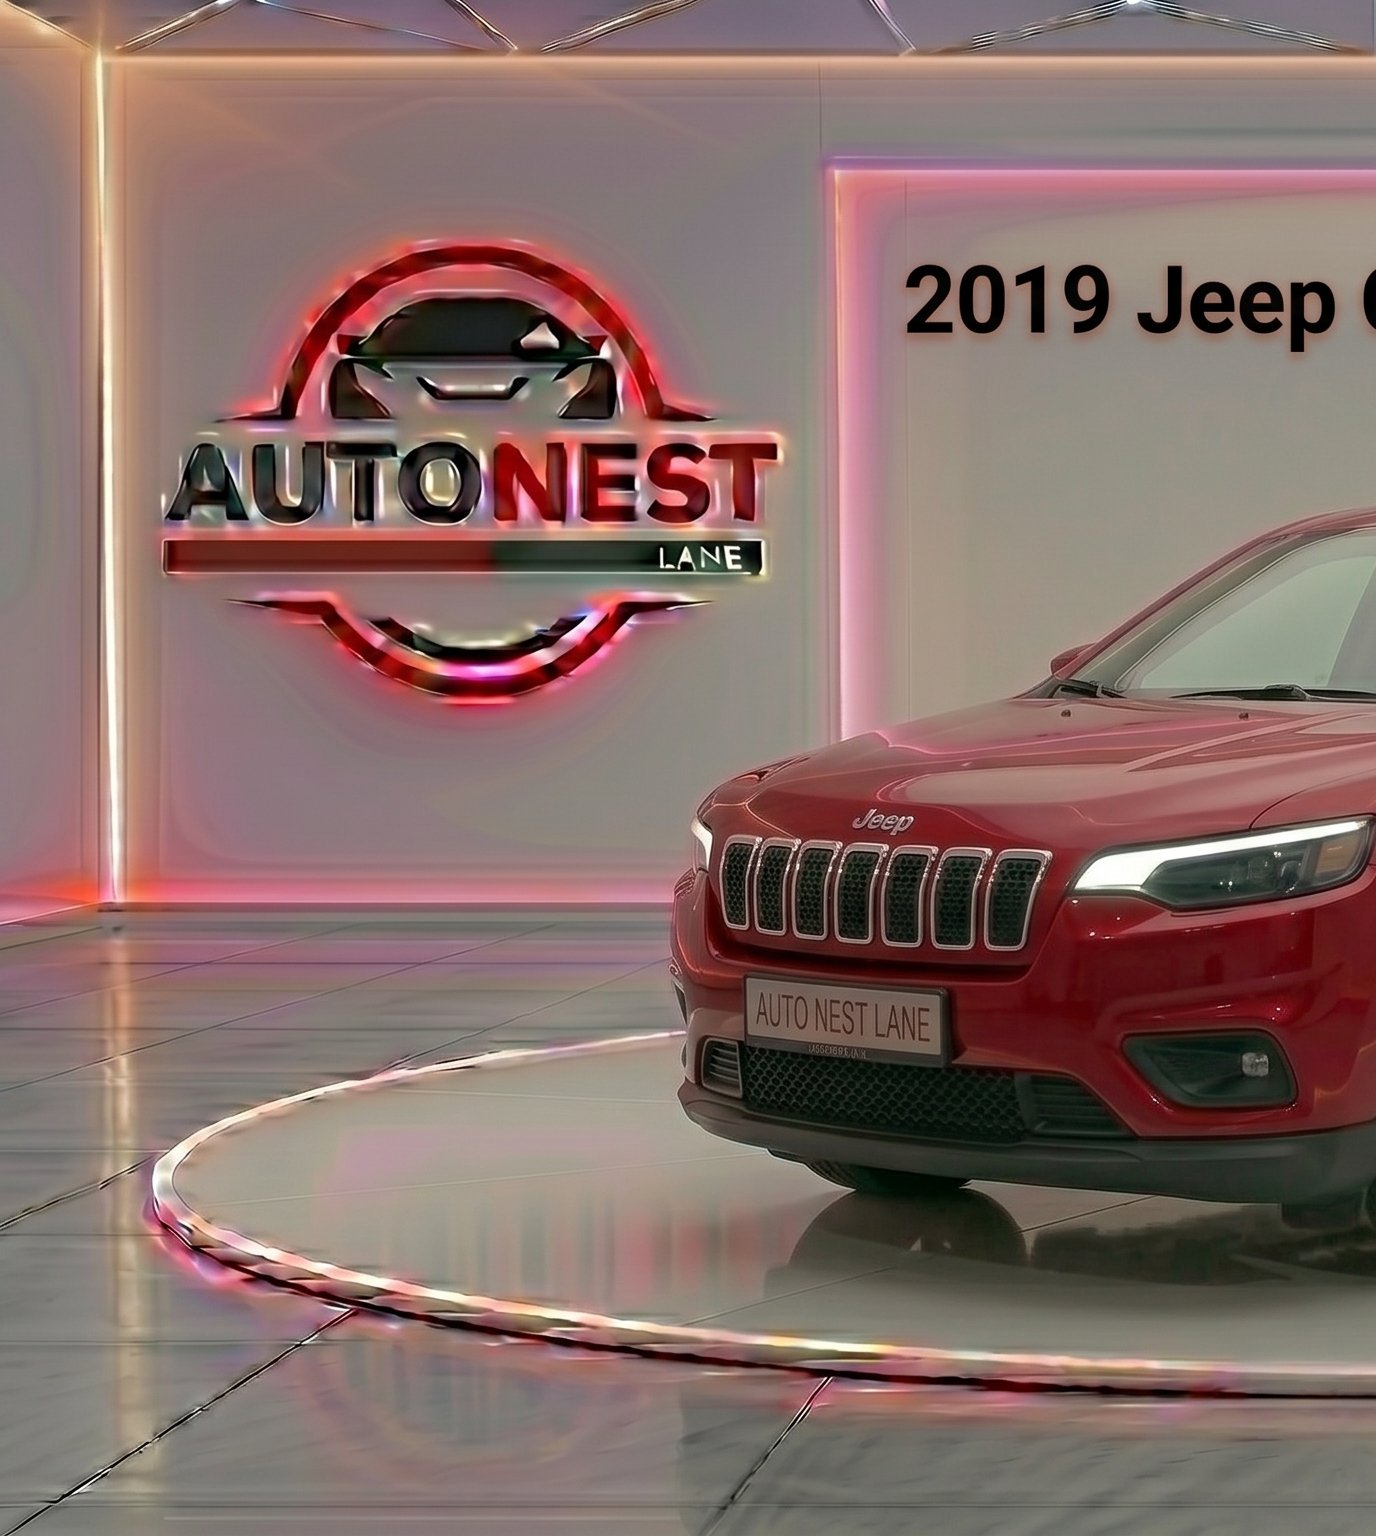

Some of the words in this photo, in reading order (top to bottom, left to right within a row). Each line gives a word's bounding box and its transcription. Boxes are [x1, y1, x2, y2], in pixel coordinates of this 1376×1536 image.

[165, 440, 780, 526] AUTONEST
[659, 545, 742, 571] LANE
[852, 808, 914, 836] Jeep
[756, 992, 808, 1031] AUTO
[815, 997, 868, 1037] NEST
[875, 1003, 931, 1043] LANE
